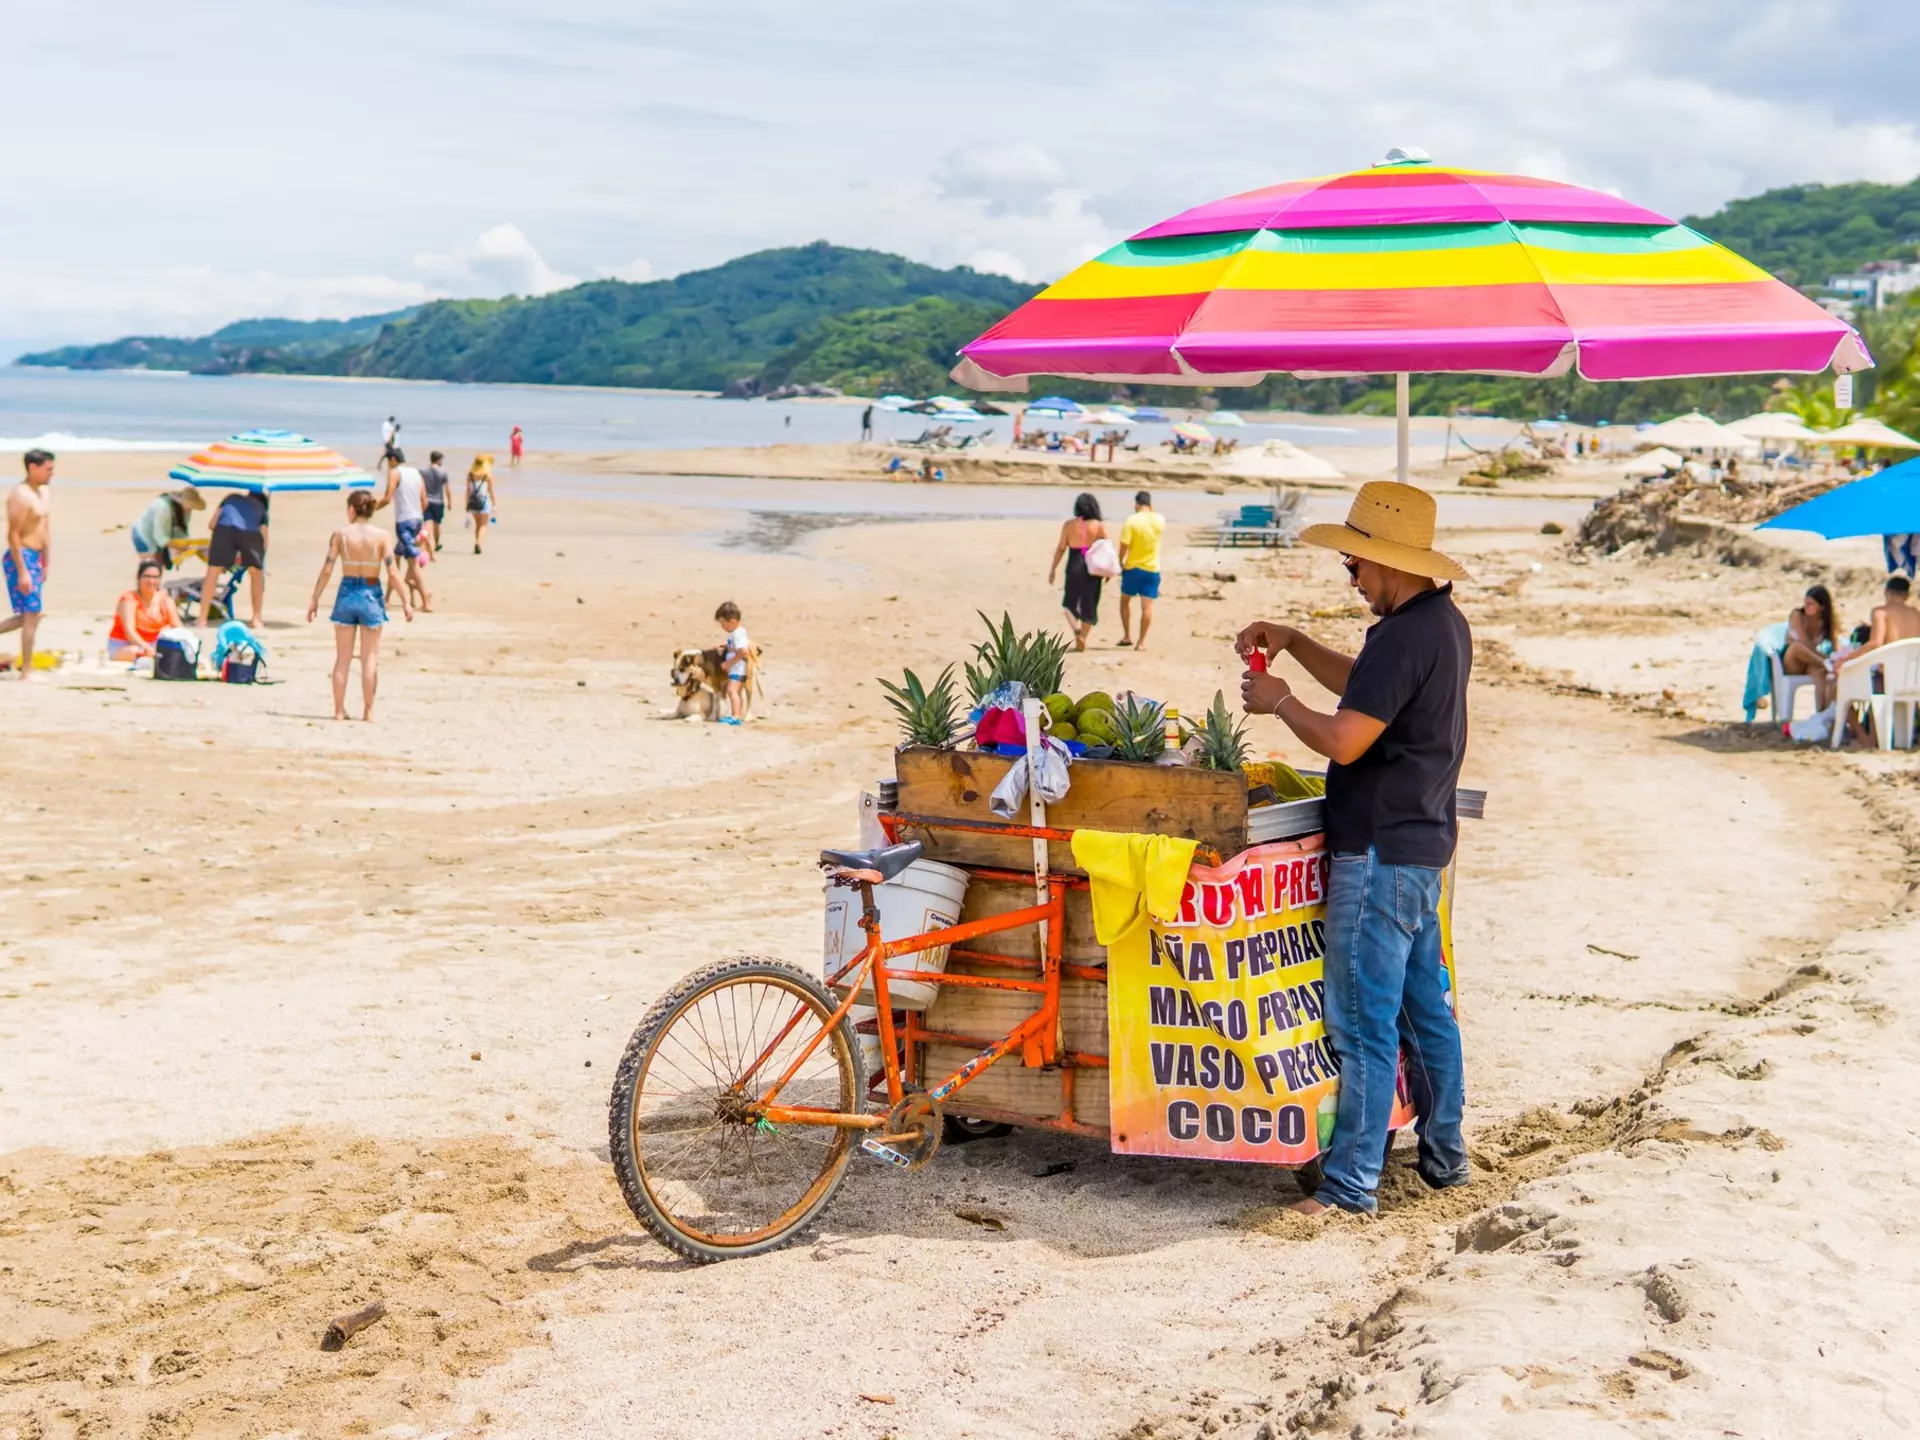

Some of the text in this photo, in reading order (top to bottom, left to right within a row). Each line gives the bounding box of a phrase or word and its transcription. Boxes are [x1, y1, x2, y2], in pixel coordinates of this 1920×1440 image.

[1150, 866, 1265, 926] RUTA
[1150, 928, 1215, 981] PÑA
[1150, 1042, 1246, 1092] VASO
[1168, 1100, 1307, 1145] COCO
